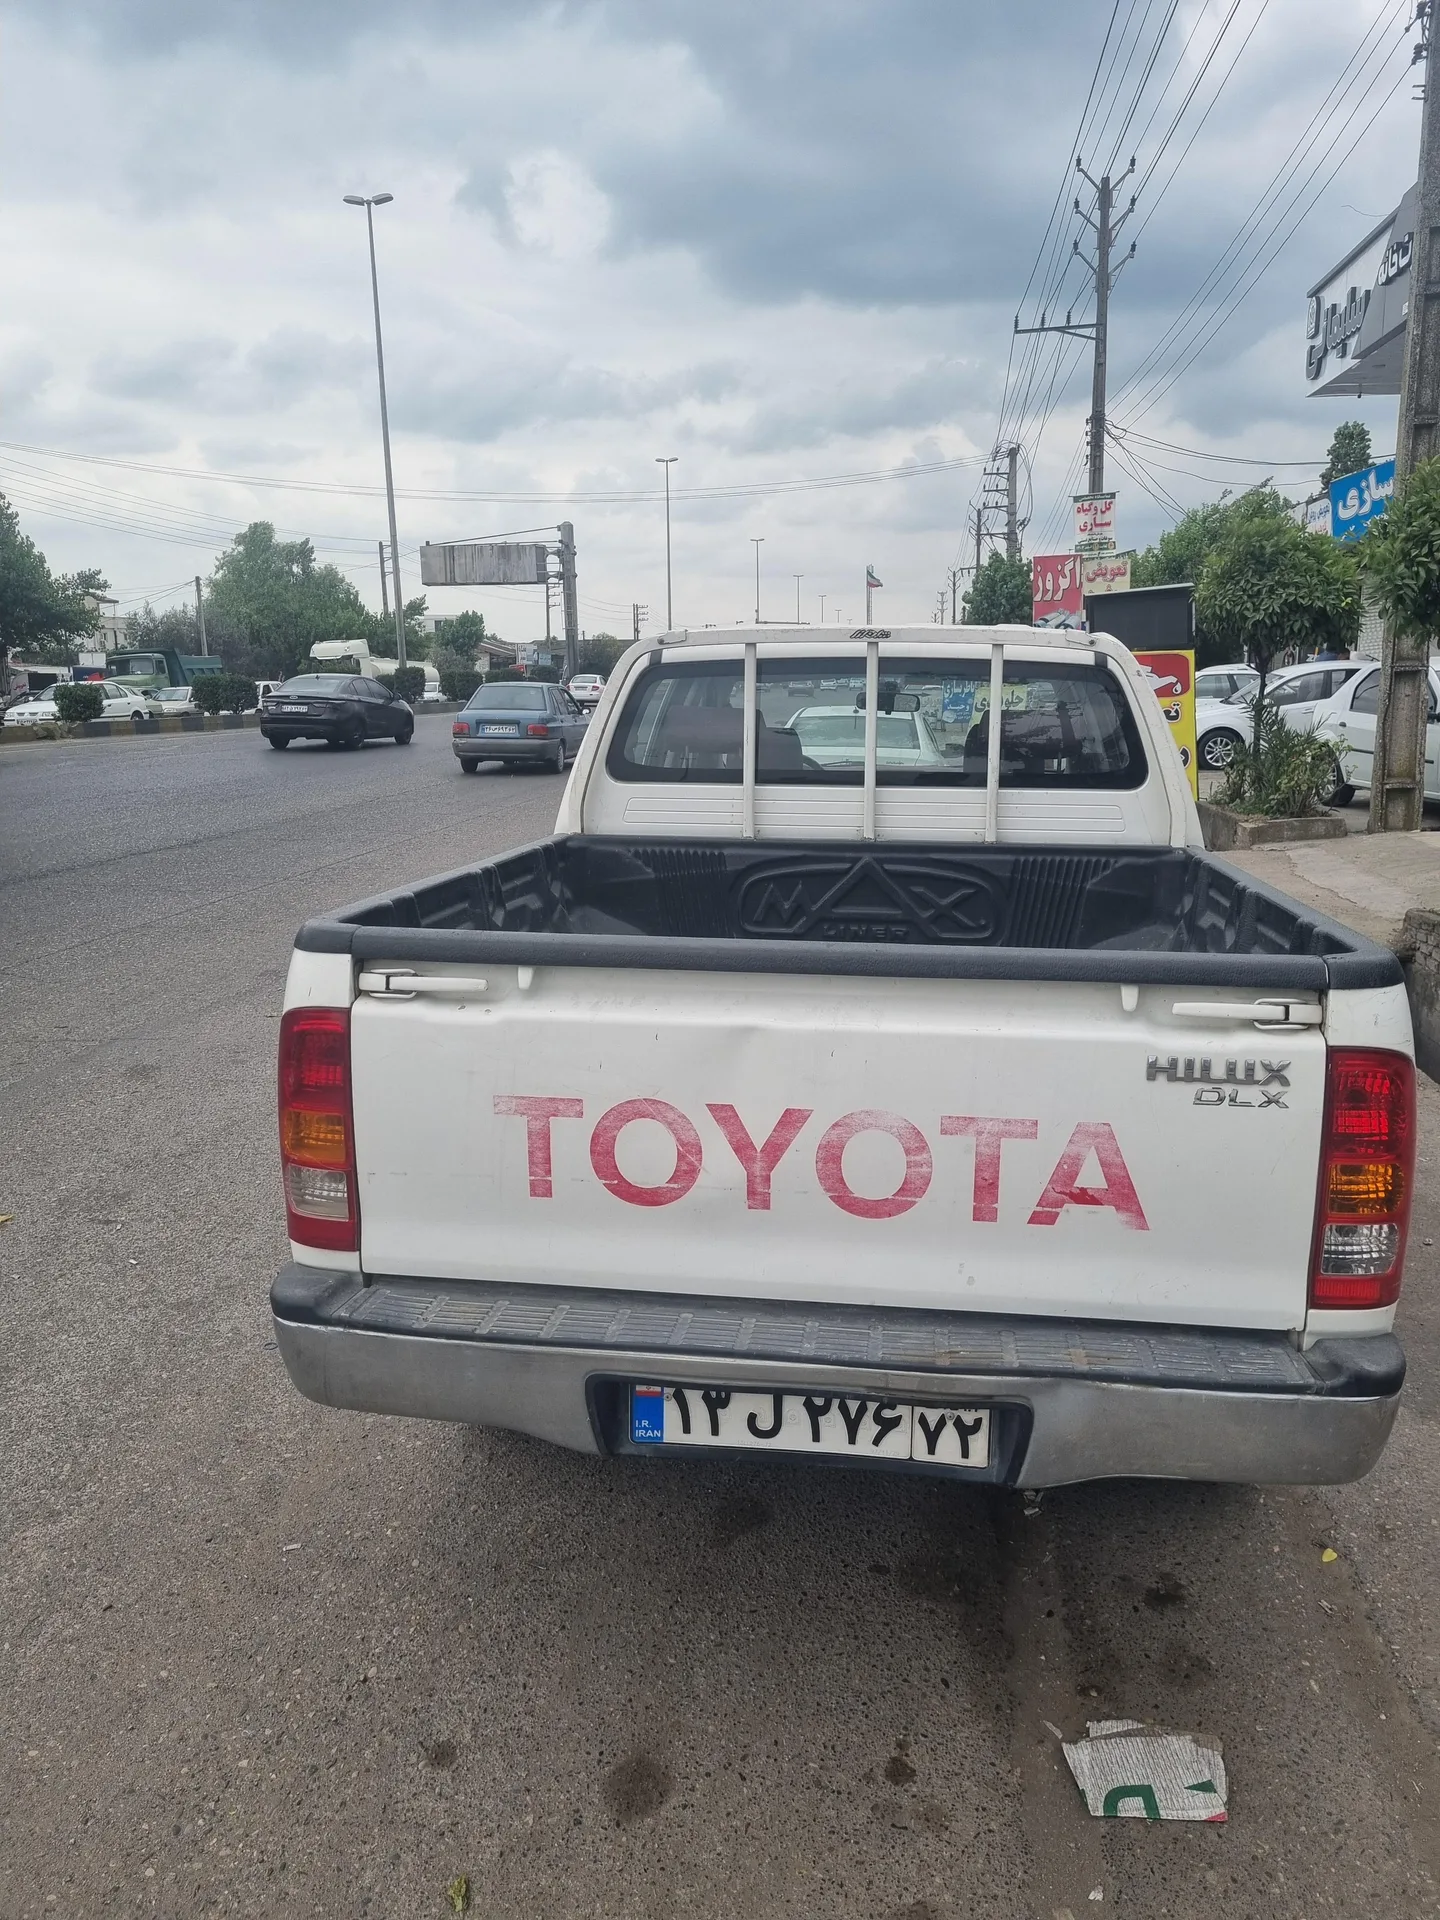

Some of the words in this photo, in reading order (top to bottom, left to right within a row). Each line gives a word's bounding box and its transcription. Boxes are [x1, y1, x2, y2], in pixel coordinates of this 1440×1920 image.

[1076, 502, 1093, 516] گیاه
[1100, 501, 1113, 514] گل
[1079, 516, 1112, 532] ساری
[1033, 556, 1081, 602] اگزوز
[1085, 561, 1129, 582] تعویض
[1147, 1055, 1291, 1086] HILUX
[1193, 1087, 1289, 1109] DLX
[493, 1095, 1150, 1231] TOYOTA
[635, 1420, 652, 1428] I.R.
[635, 1430, 661, 1438] IRAN
